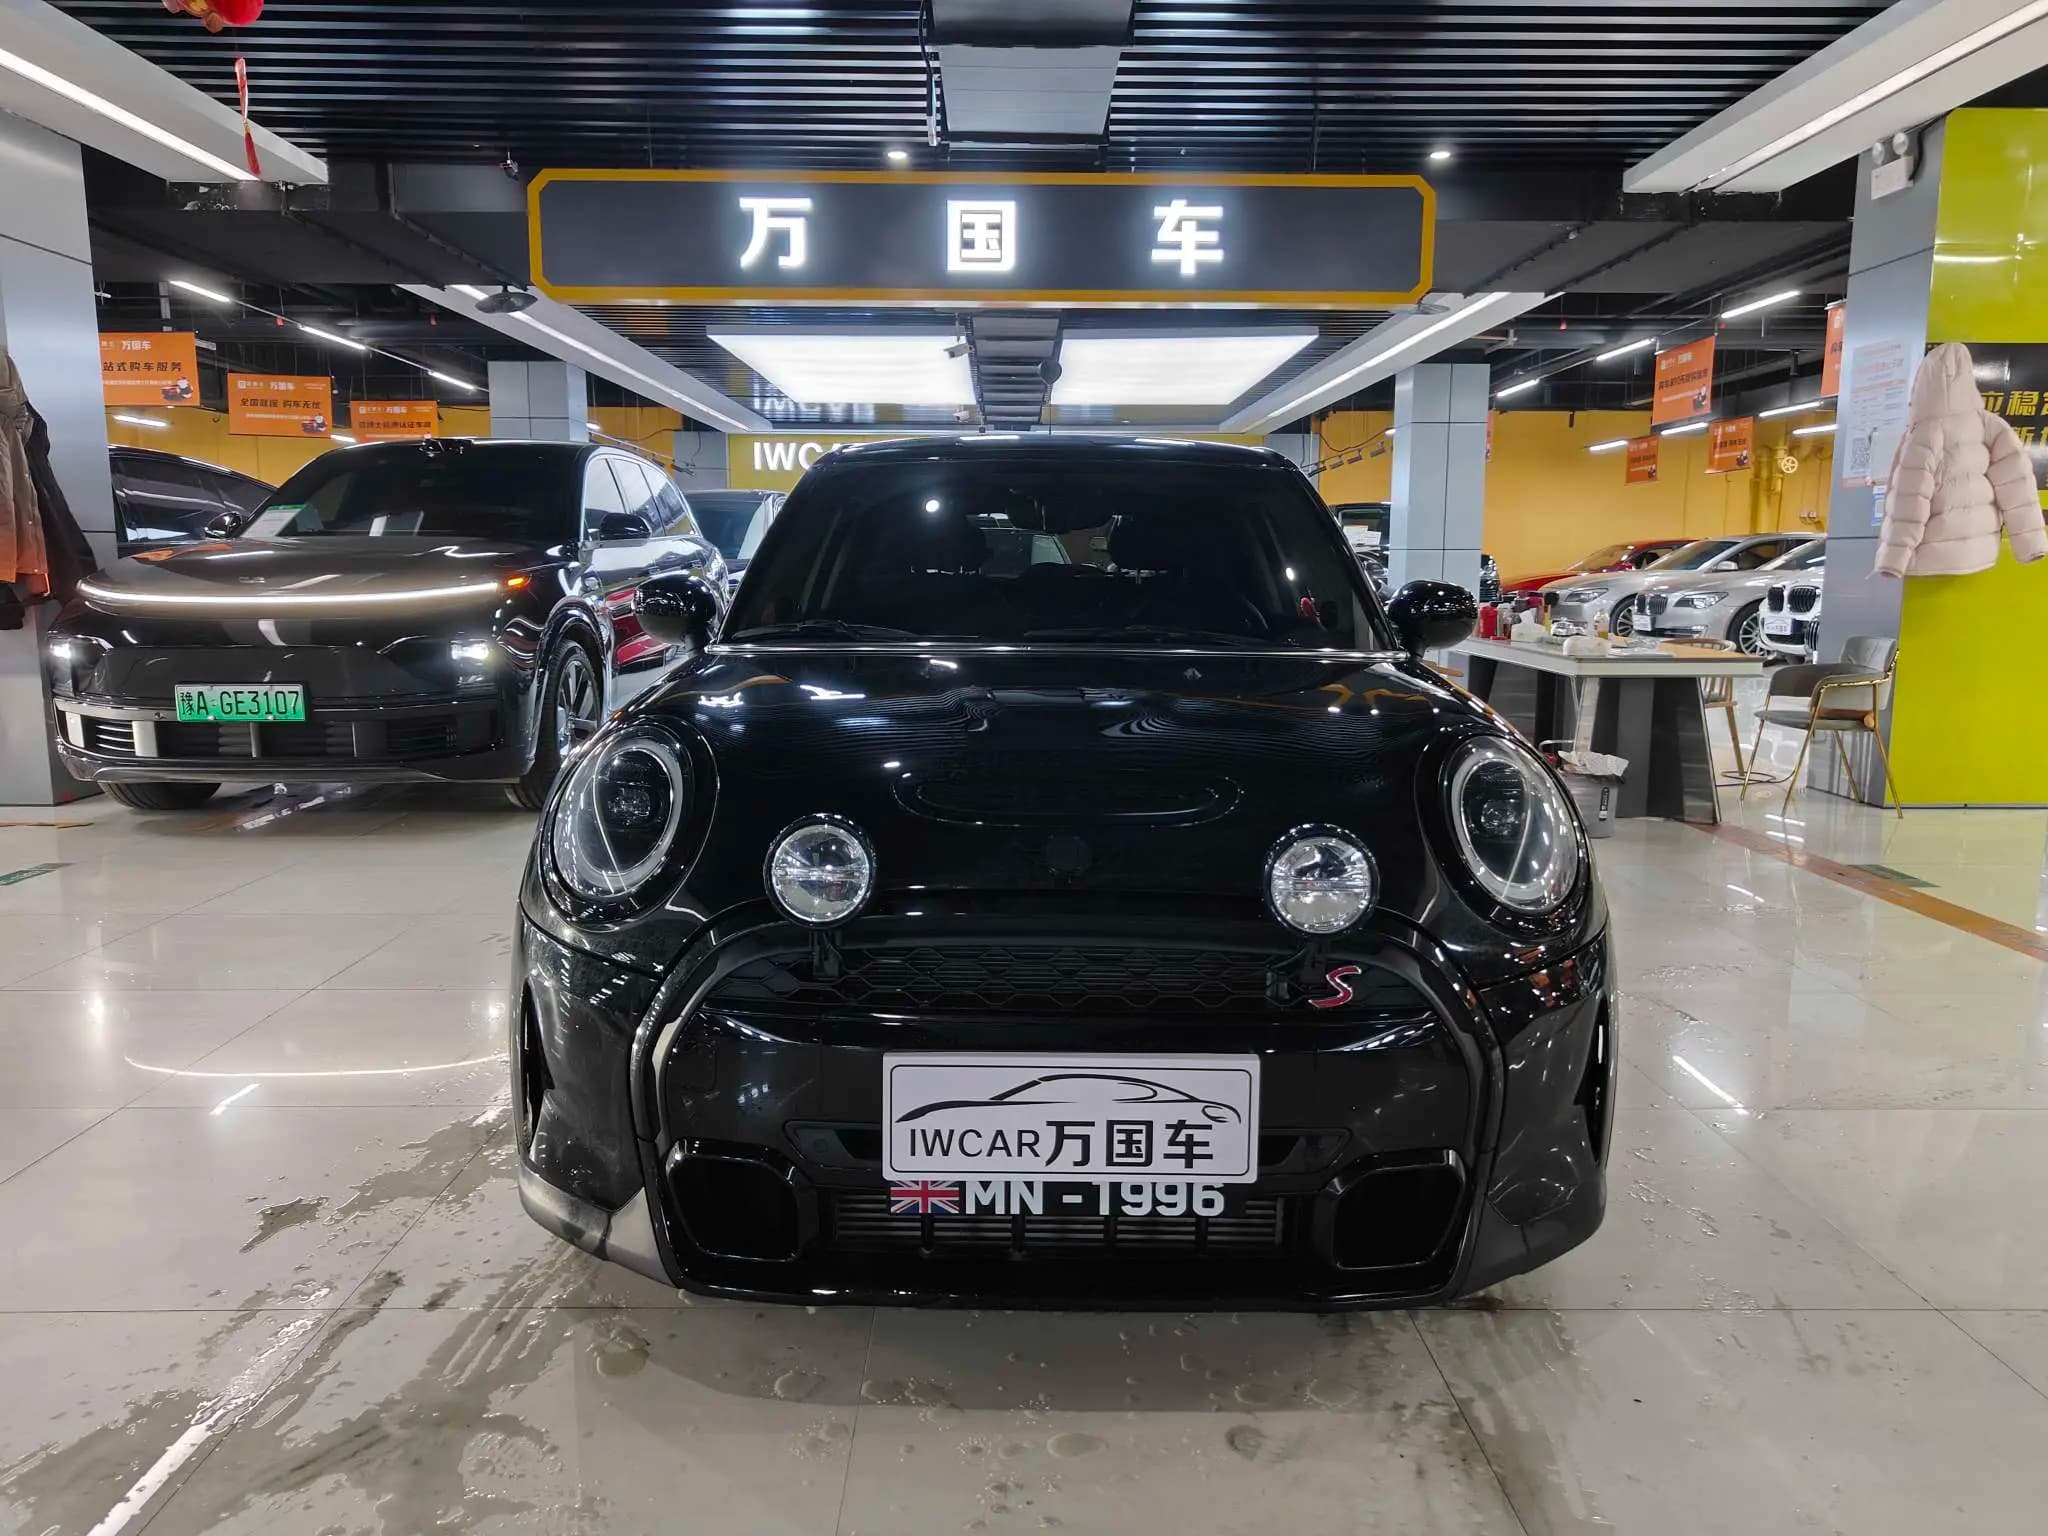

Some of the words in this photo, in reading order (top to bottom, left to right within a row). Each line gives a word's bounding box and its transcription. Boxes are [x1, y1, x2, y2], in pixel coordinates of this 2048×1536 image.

[738, 197, 1226, 276] 万国车
[753, 441, 848, 472] IWC
[1308, 965, 1362, 1008] S
